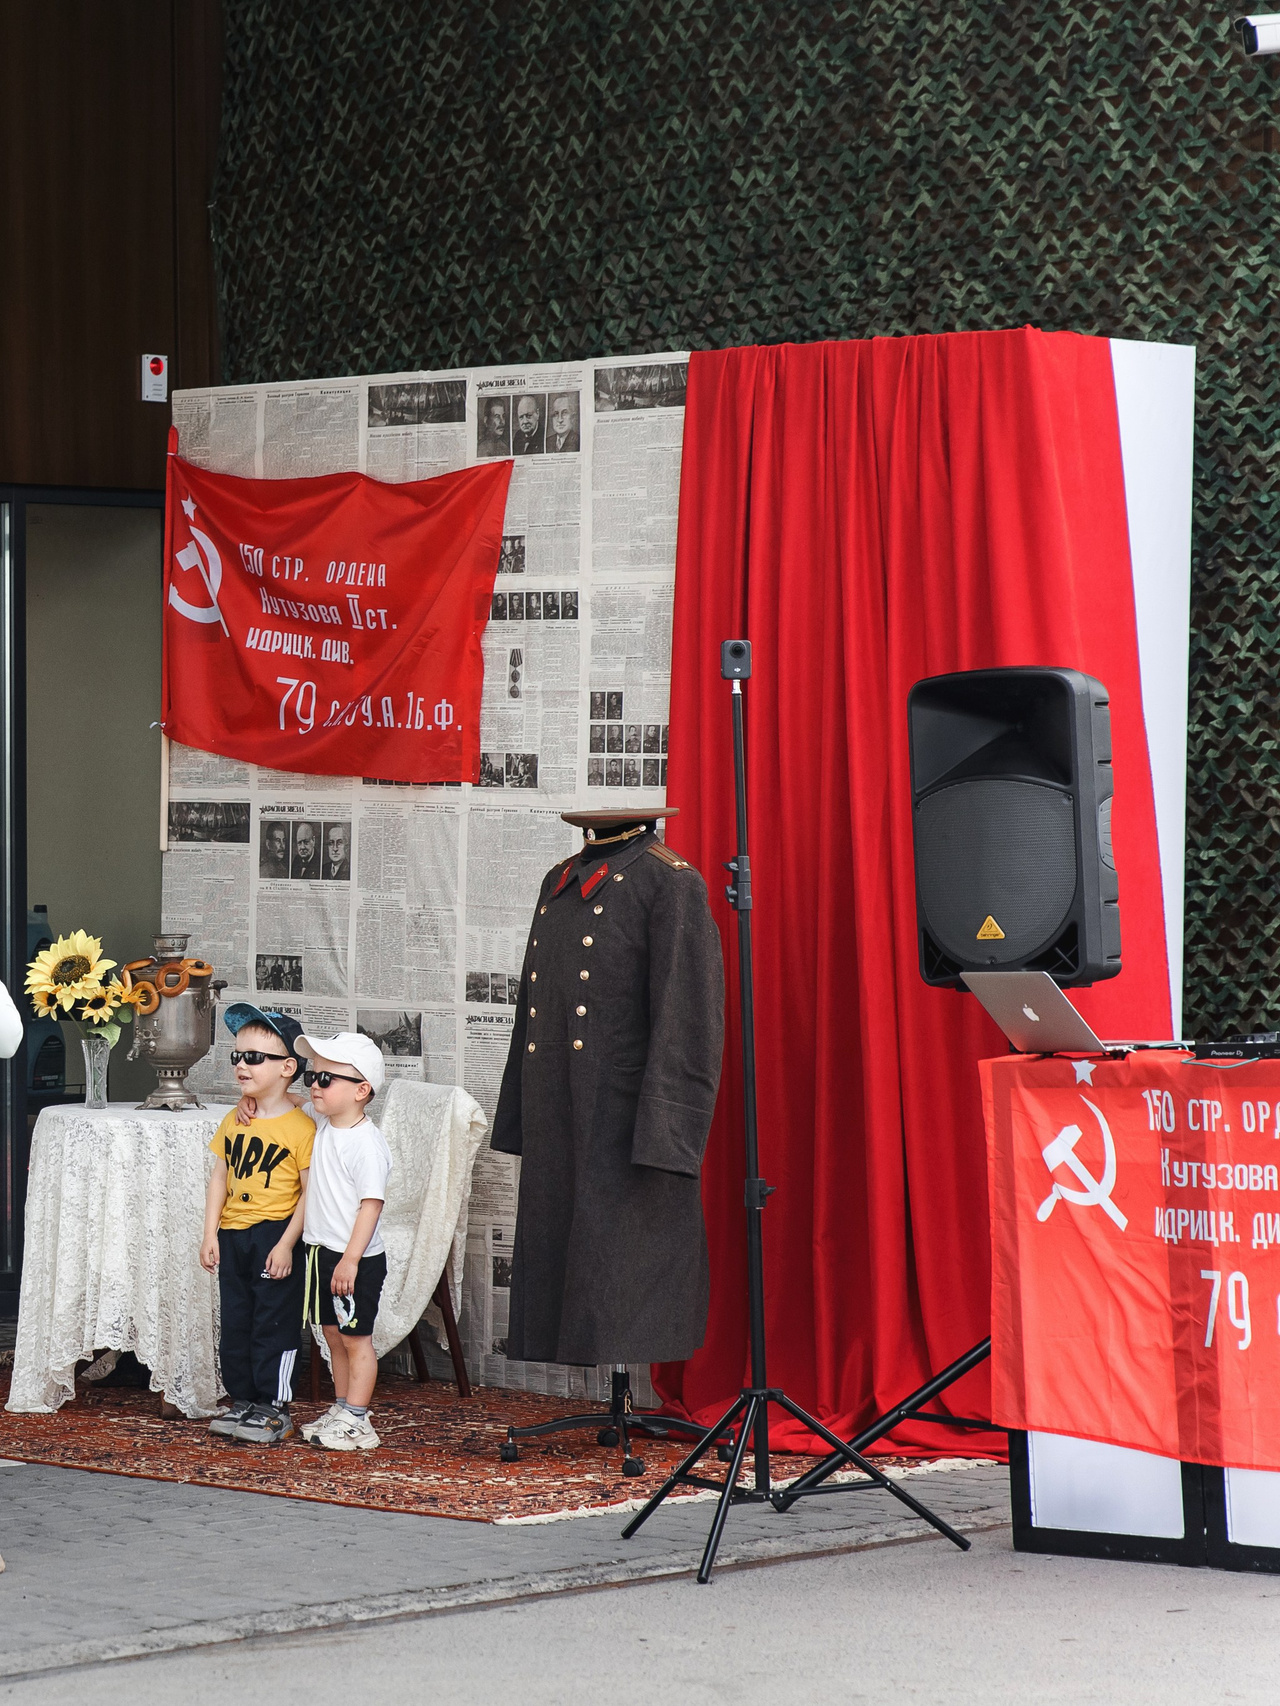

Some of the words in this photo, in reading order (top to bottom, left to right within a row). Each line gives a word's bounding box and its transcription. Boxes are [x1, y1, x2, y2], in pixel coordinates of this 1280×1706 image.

[239, 543, 264, 577] 150
[272, 556, 309, 582] СТР.
[326, 560, 387, 587] ОРДЕНА
[260, 587, 342, 626] КУТУЗОВА
[245, 627, 317, 659] ИДРИЦК.
[320, 640, 355, 665] ДИВ.
[276, 677, 317, 734] 79
[1141, 1089, 1176, 1133] 150
[1188, 1099, 1231, 1132] СТР.
[1242, 1101, 1280, 1140] ОР
[1161, 1147, 1279, 1191] КУТУЗОВА
[1155, 1206, 1240, 1248] ИДРИЦК.
[1200, 1269, 1252, 1351] 79
